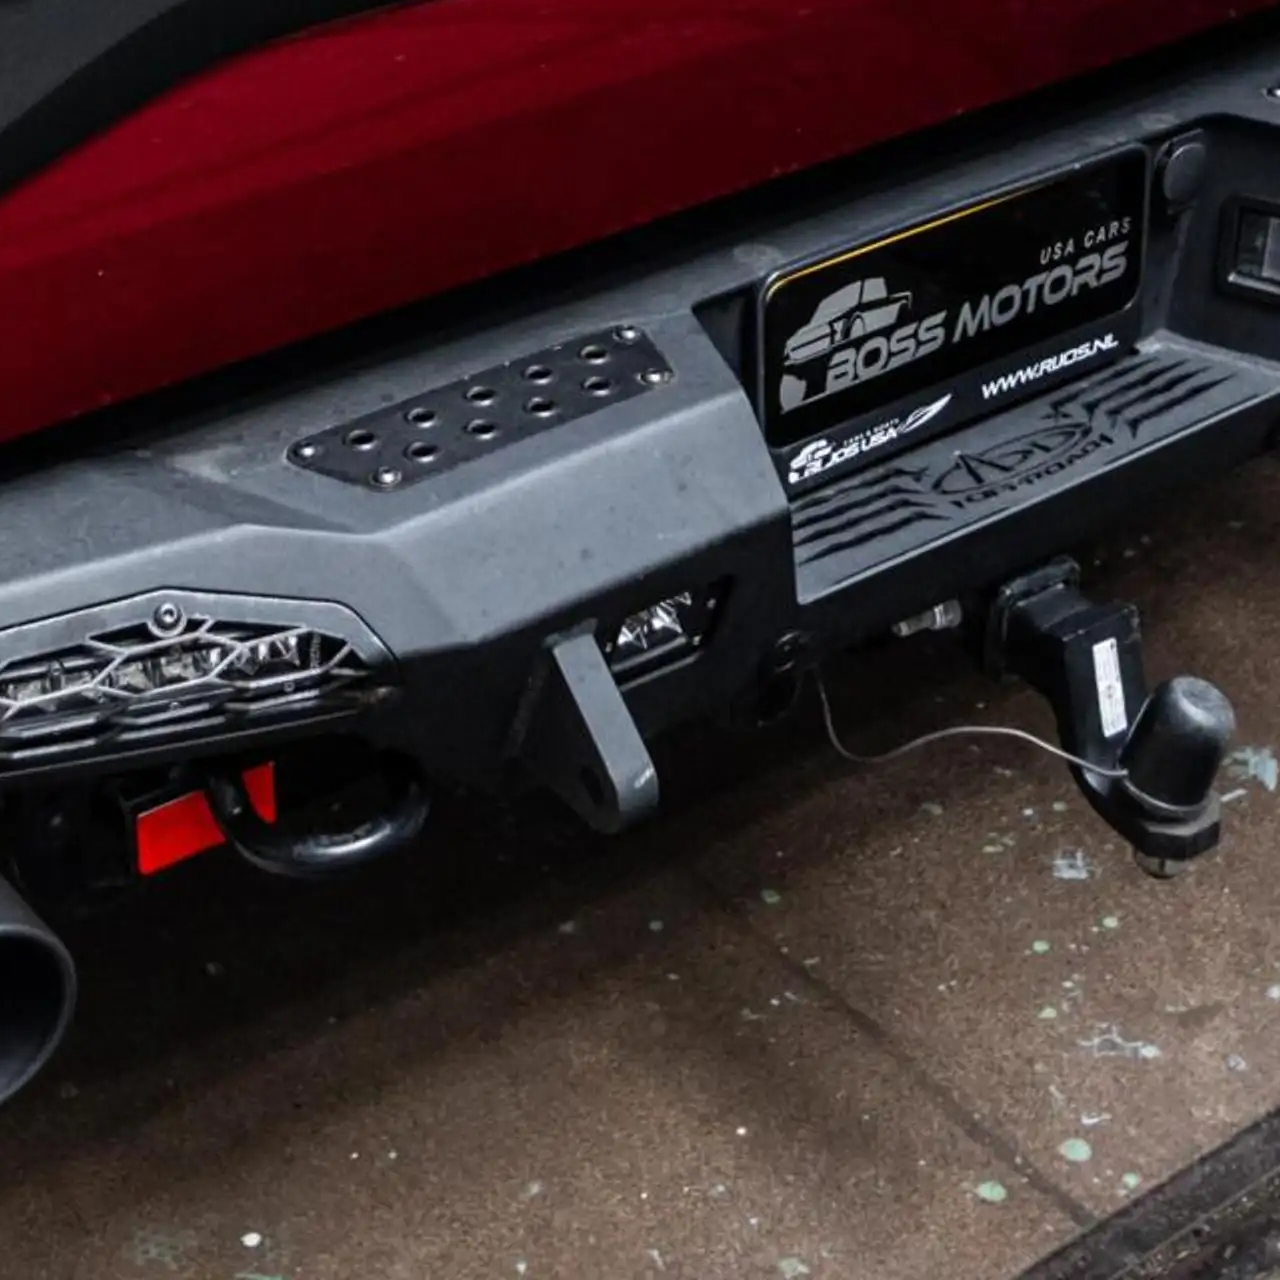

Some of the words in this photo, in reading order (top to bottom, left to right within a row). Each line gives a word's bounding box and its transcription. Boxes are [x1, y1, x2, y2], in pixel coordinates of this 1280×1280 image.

[1040, 238, 1075, 265] USA
[1084, 217, 1131, 249] CARS
[825, 309, 947, 395] BOSS
[952, 240, 1129, 343] MOTORS
